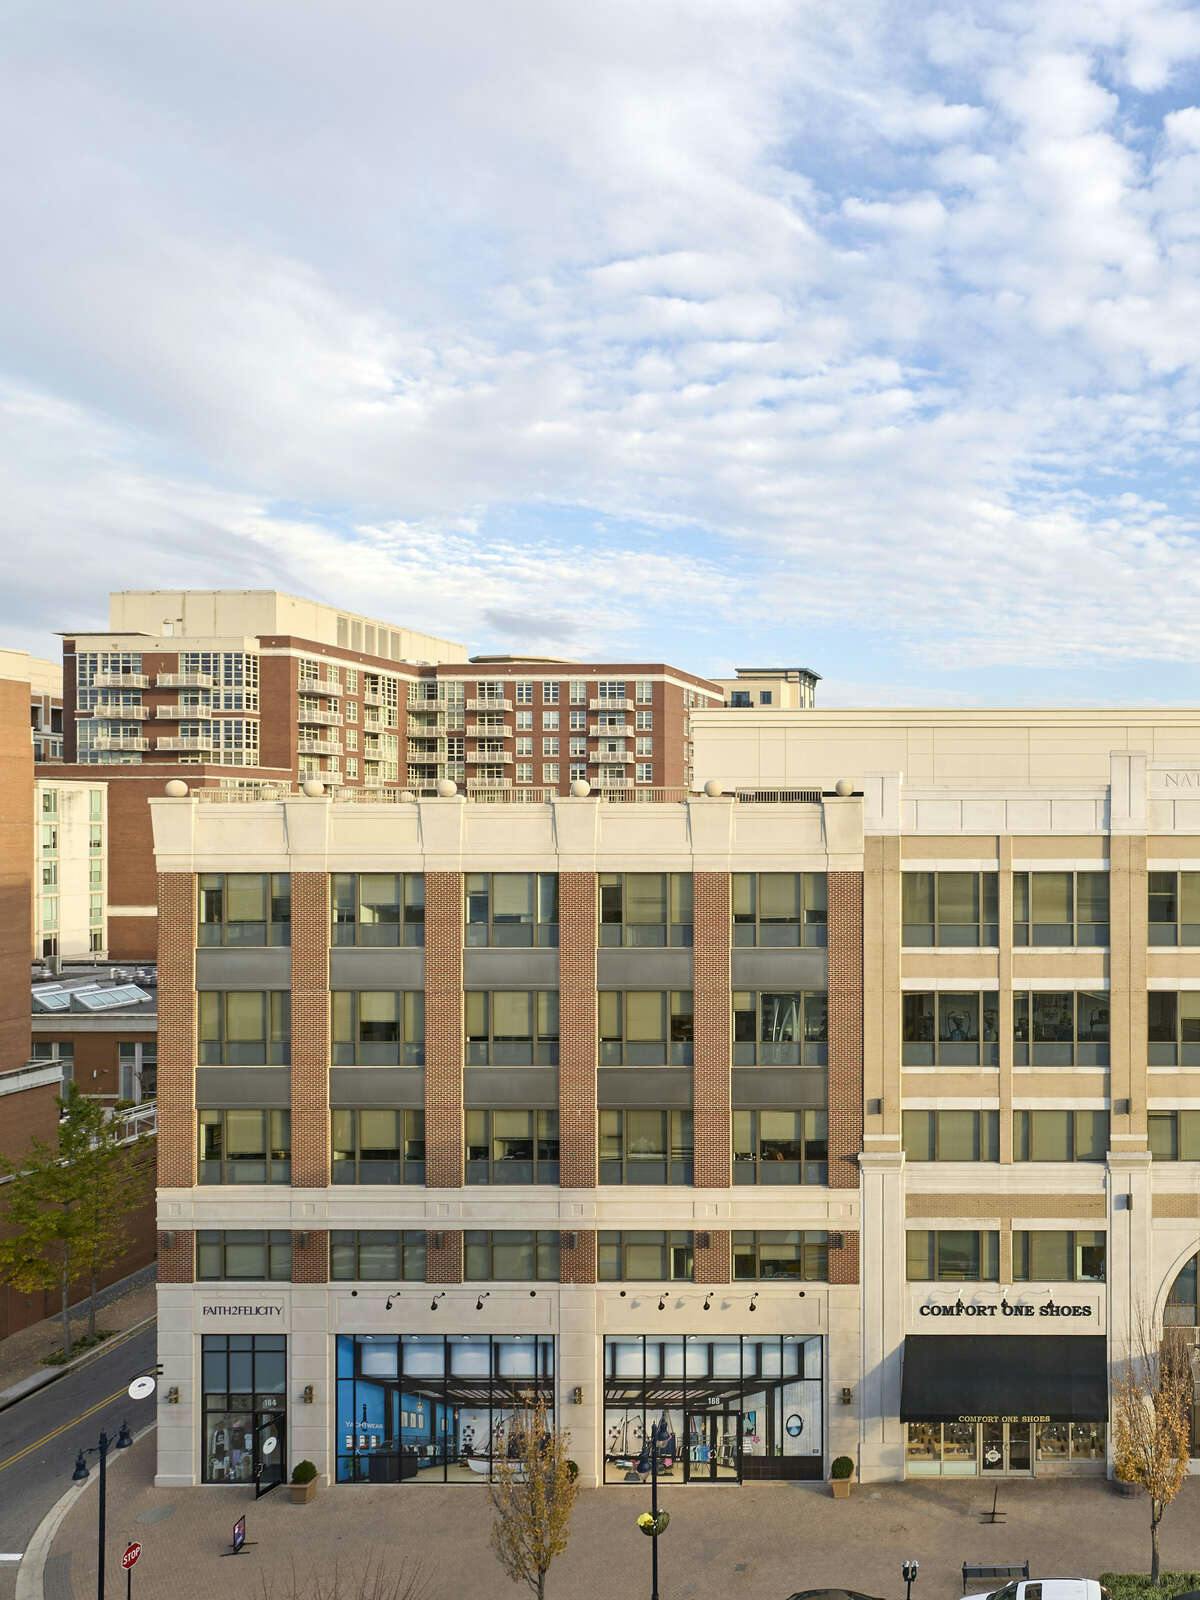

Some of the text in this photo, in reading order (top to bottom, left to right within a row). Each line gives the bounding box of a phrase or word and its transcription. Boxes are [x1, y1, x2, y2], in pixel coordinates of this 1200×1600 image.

[203, 1305, 282, 1316] FAITH2FELICITY
[919, 1305, 1092, 1317] COMFORT ONE SHOES
[123, 1546, 141, 1565] STOP
